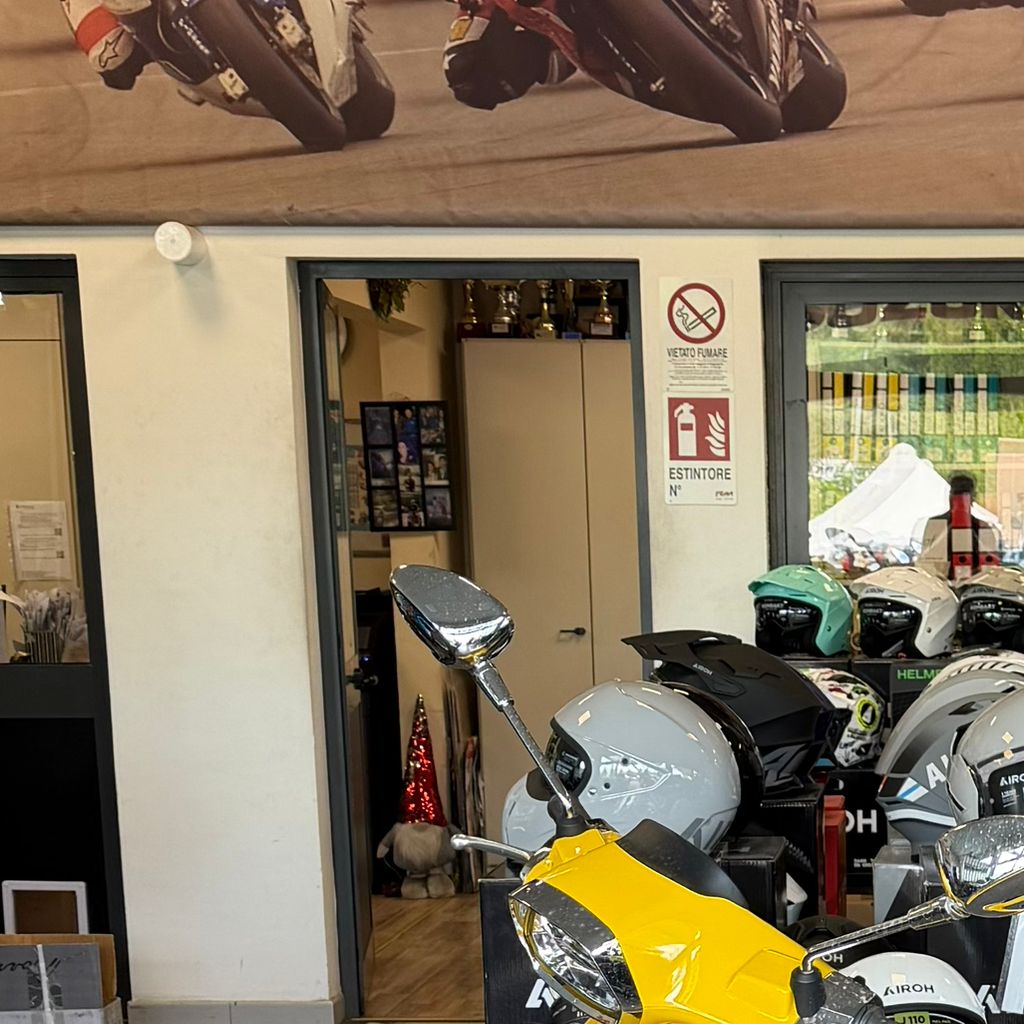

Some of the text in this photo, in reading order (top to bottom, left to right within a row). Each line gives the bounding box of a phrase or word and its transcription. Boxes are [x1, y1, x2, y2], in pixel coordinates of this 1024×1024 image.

[667, 347, 728, 358] VIETATO FUMARE
[669, 467, 731, 480] ESTINTORE
[883, 983, 934, 996] AIROH
